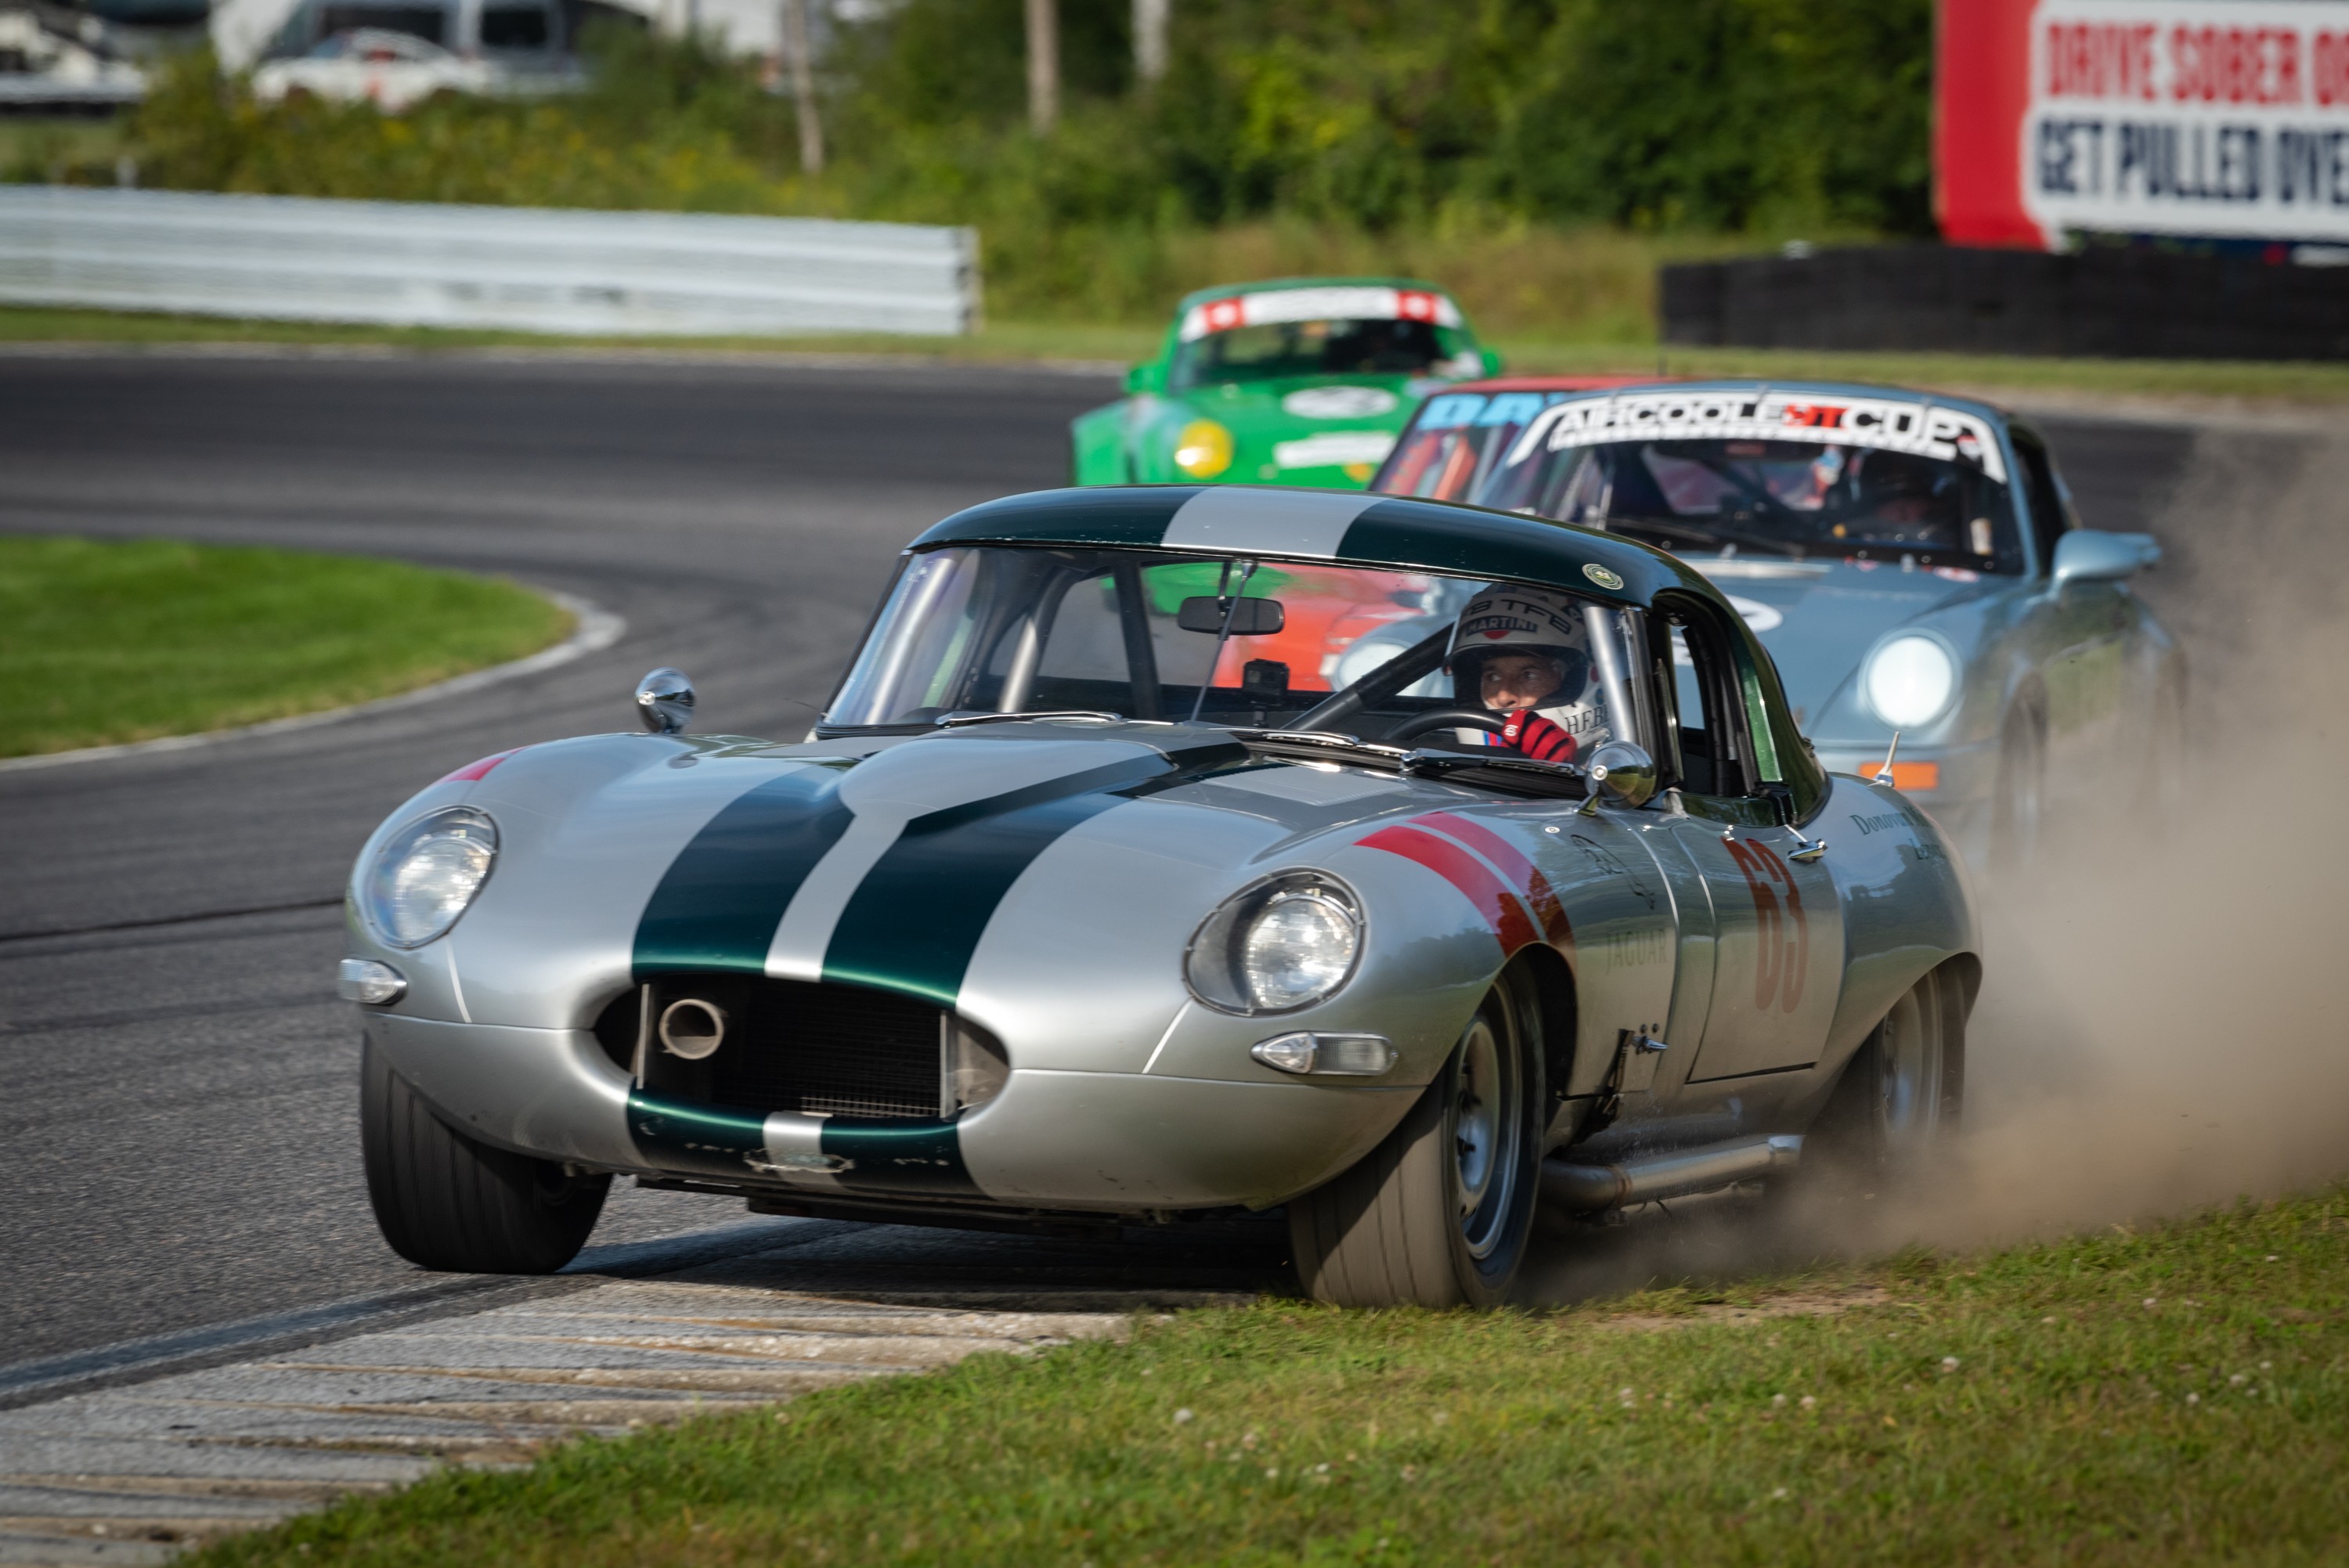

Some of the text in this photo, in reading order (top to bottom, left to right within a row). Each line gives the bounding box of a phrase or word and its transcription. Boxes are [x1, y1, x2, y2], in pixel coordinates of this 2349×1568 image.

[2048, 23, 2156, 102] DRIVE
[2173, 26, 2300, 106] SOBER
[2039, 118, 2103, 194] GET
[2119, 121, 2261, 201] PULLED
[1467, 616, 1539, 636] MARTINI
[1605, 928, 1667, 976] JAGUAR
[1720, 834, 1808, 1014] 63
